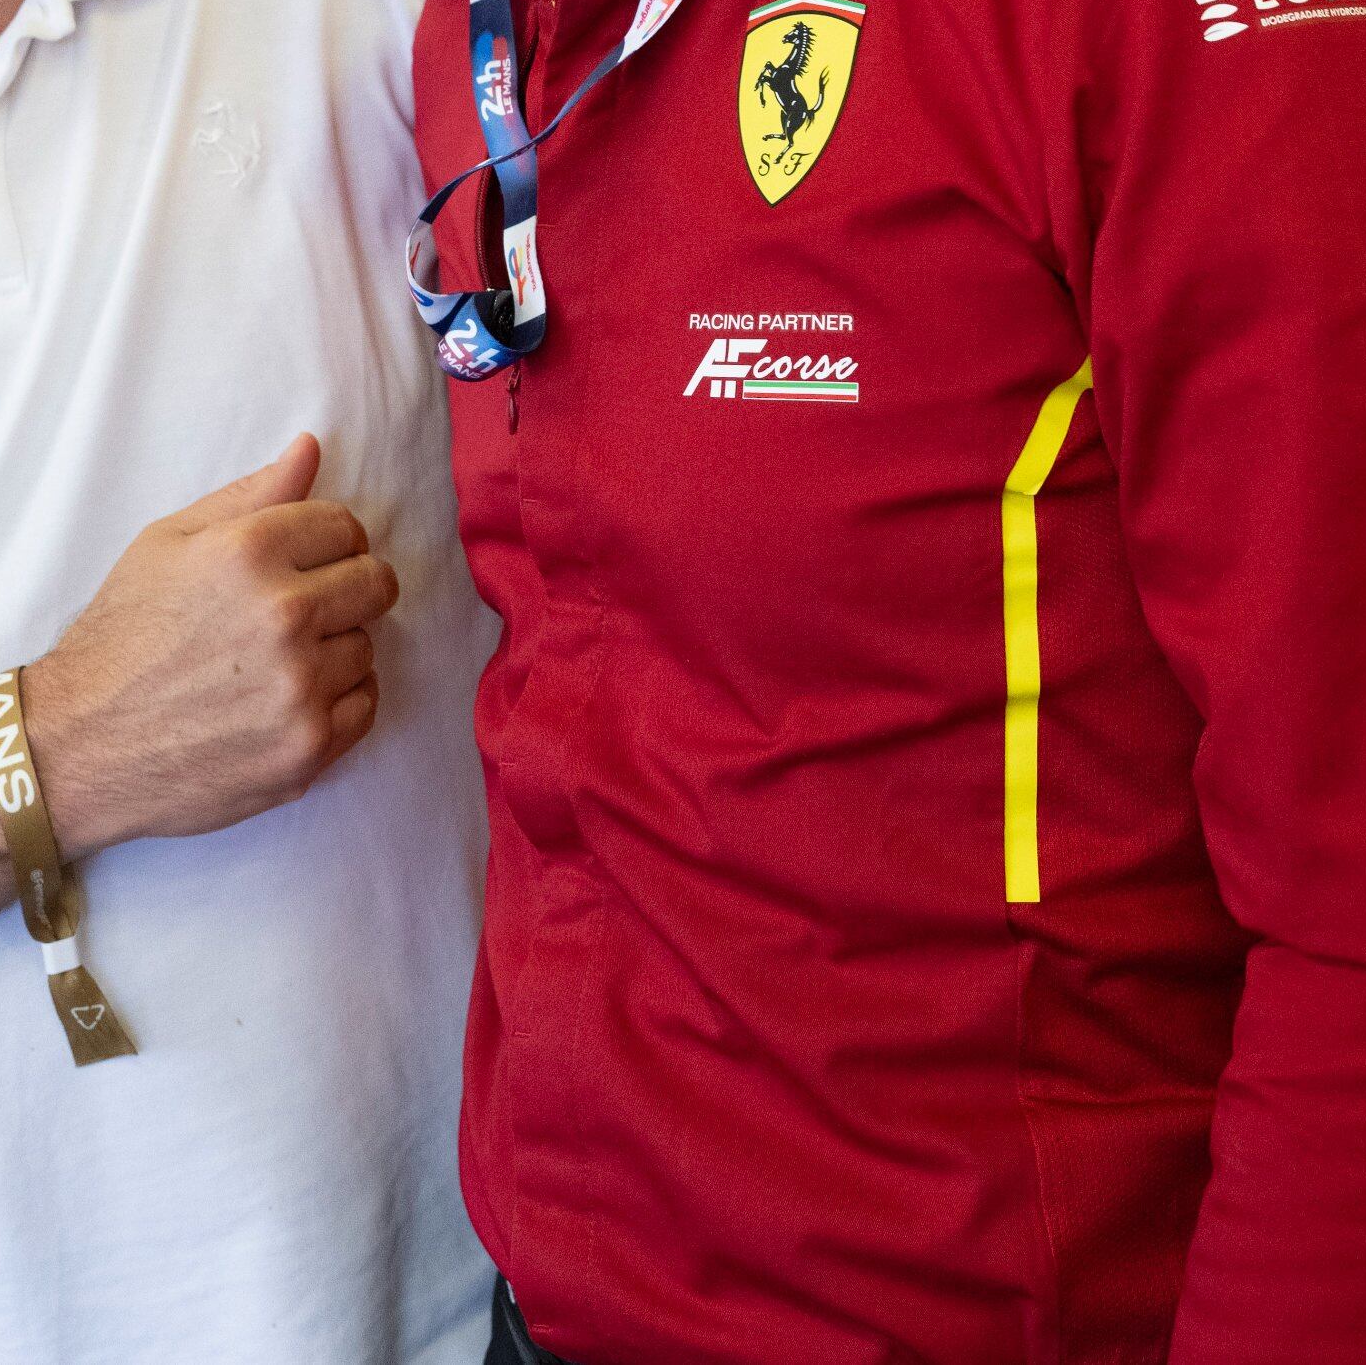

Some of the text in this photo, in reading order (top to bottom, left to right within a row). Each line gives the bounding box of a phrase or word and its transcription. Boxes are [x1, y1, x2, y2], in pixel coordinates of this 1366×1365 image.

[1260, 8, 1330, 27] BIODEGRADABLE
[476, 60, 507, 121] 24h
[502, 60, 513, 114] LE MANS
[445, 318, 501, 373] 24h
[689, 314, 854, 332] RACING PARTNER
